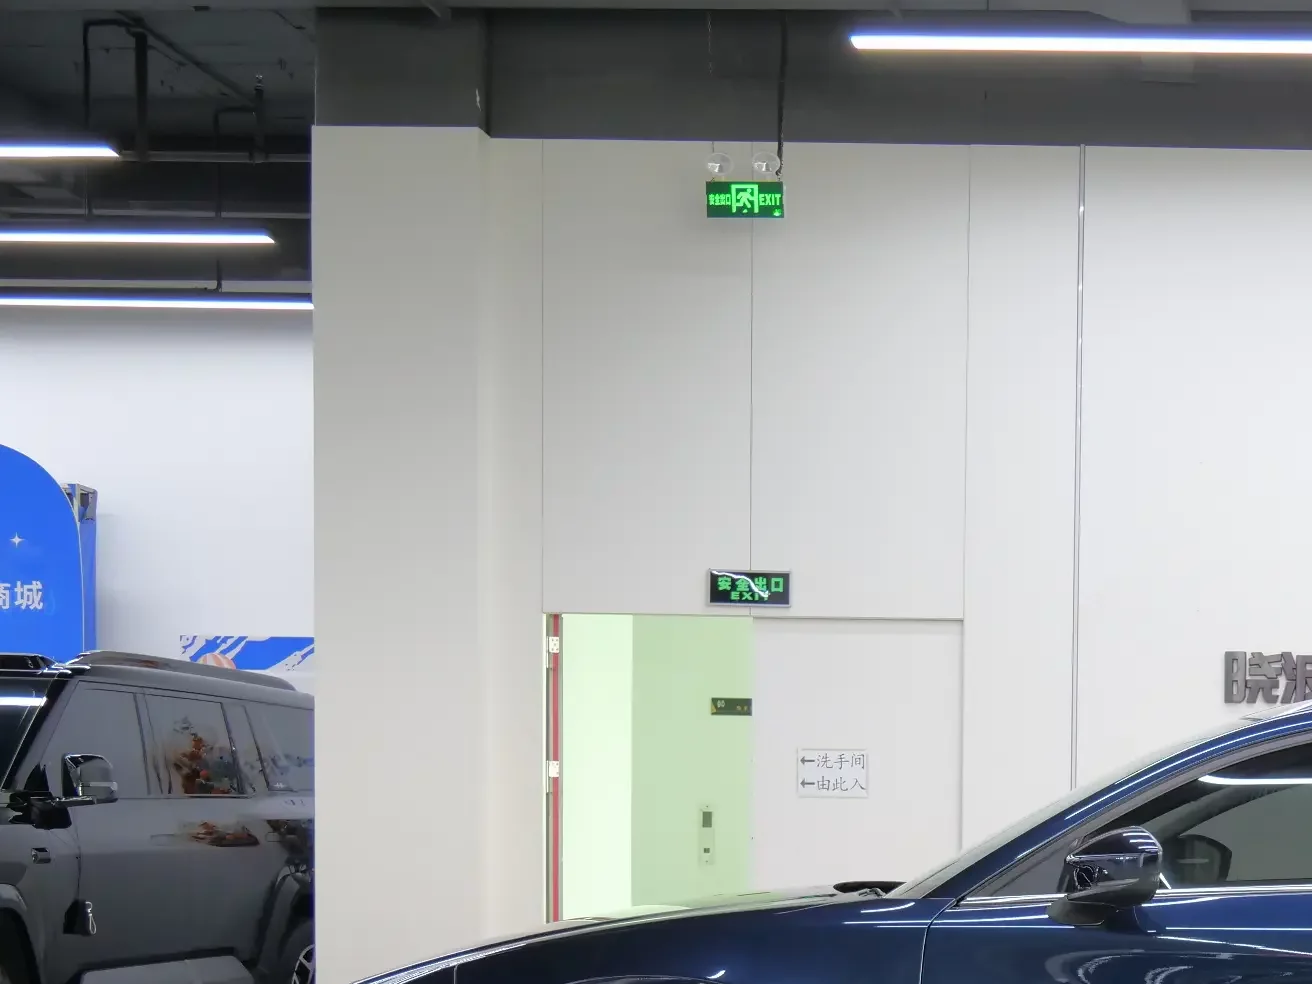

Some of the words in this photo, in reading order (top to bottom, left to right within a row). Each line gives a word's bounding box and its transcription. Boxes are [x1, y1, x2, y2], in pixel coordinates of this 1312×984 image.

[759, 193, 782, 206] EXIT
[717, 576, 784, 593] 安全出口
[816, 752, 866, 770] 洗手间
[816, 775, 867, 792] 由此入
